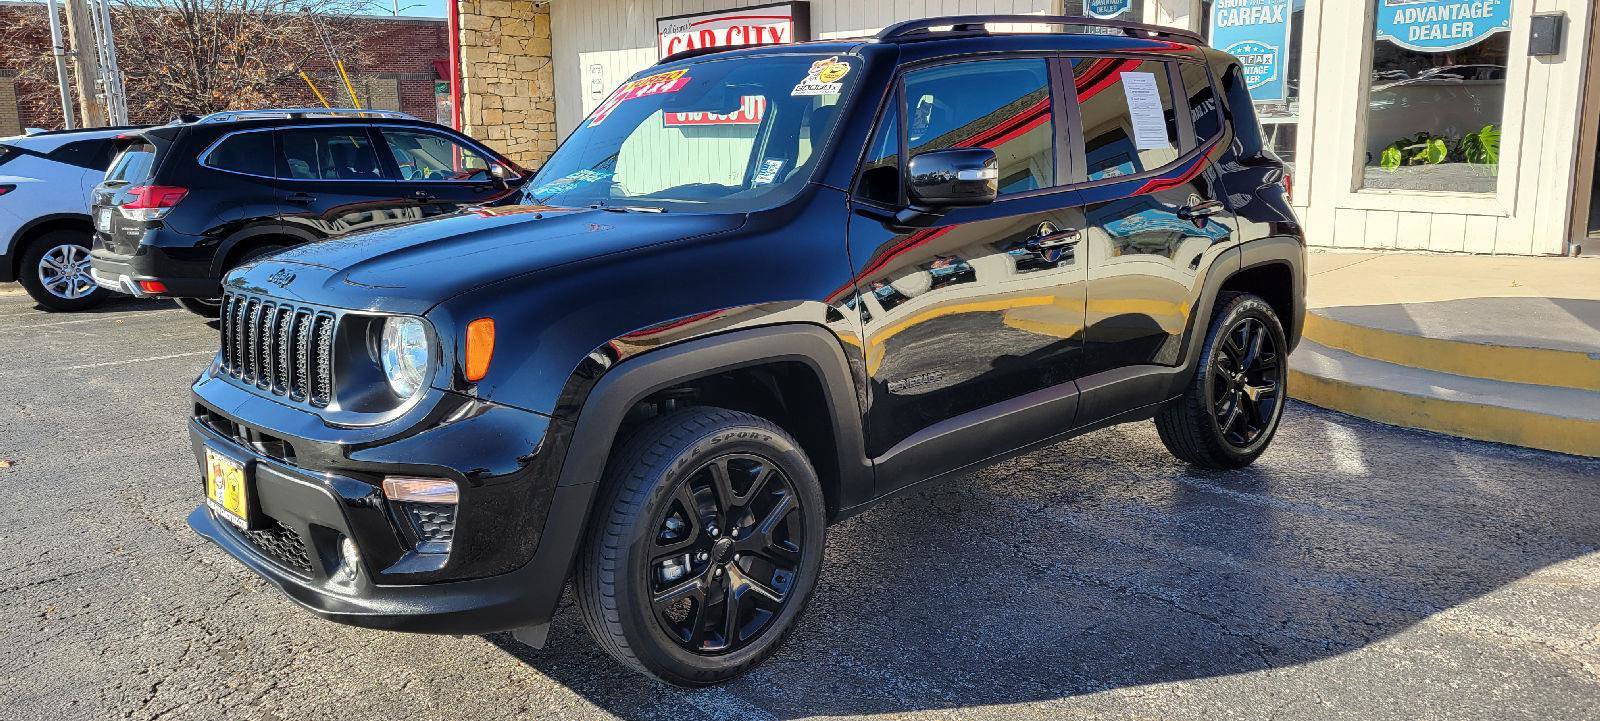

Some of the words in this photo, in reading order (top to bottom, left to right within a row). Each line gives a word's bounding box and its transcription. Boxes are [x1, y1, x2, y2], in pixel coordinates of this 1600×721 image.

[1217, 5, 1284, 28] CARFAX
[1393, 2, 1493, 25] ADVANTAGE
[1408, 21, 1474, 41] DEALER
[710, 431, 773, 446] SPORT
